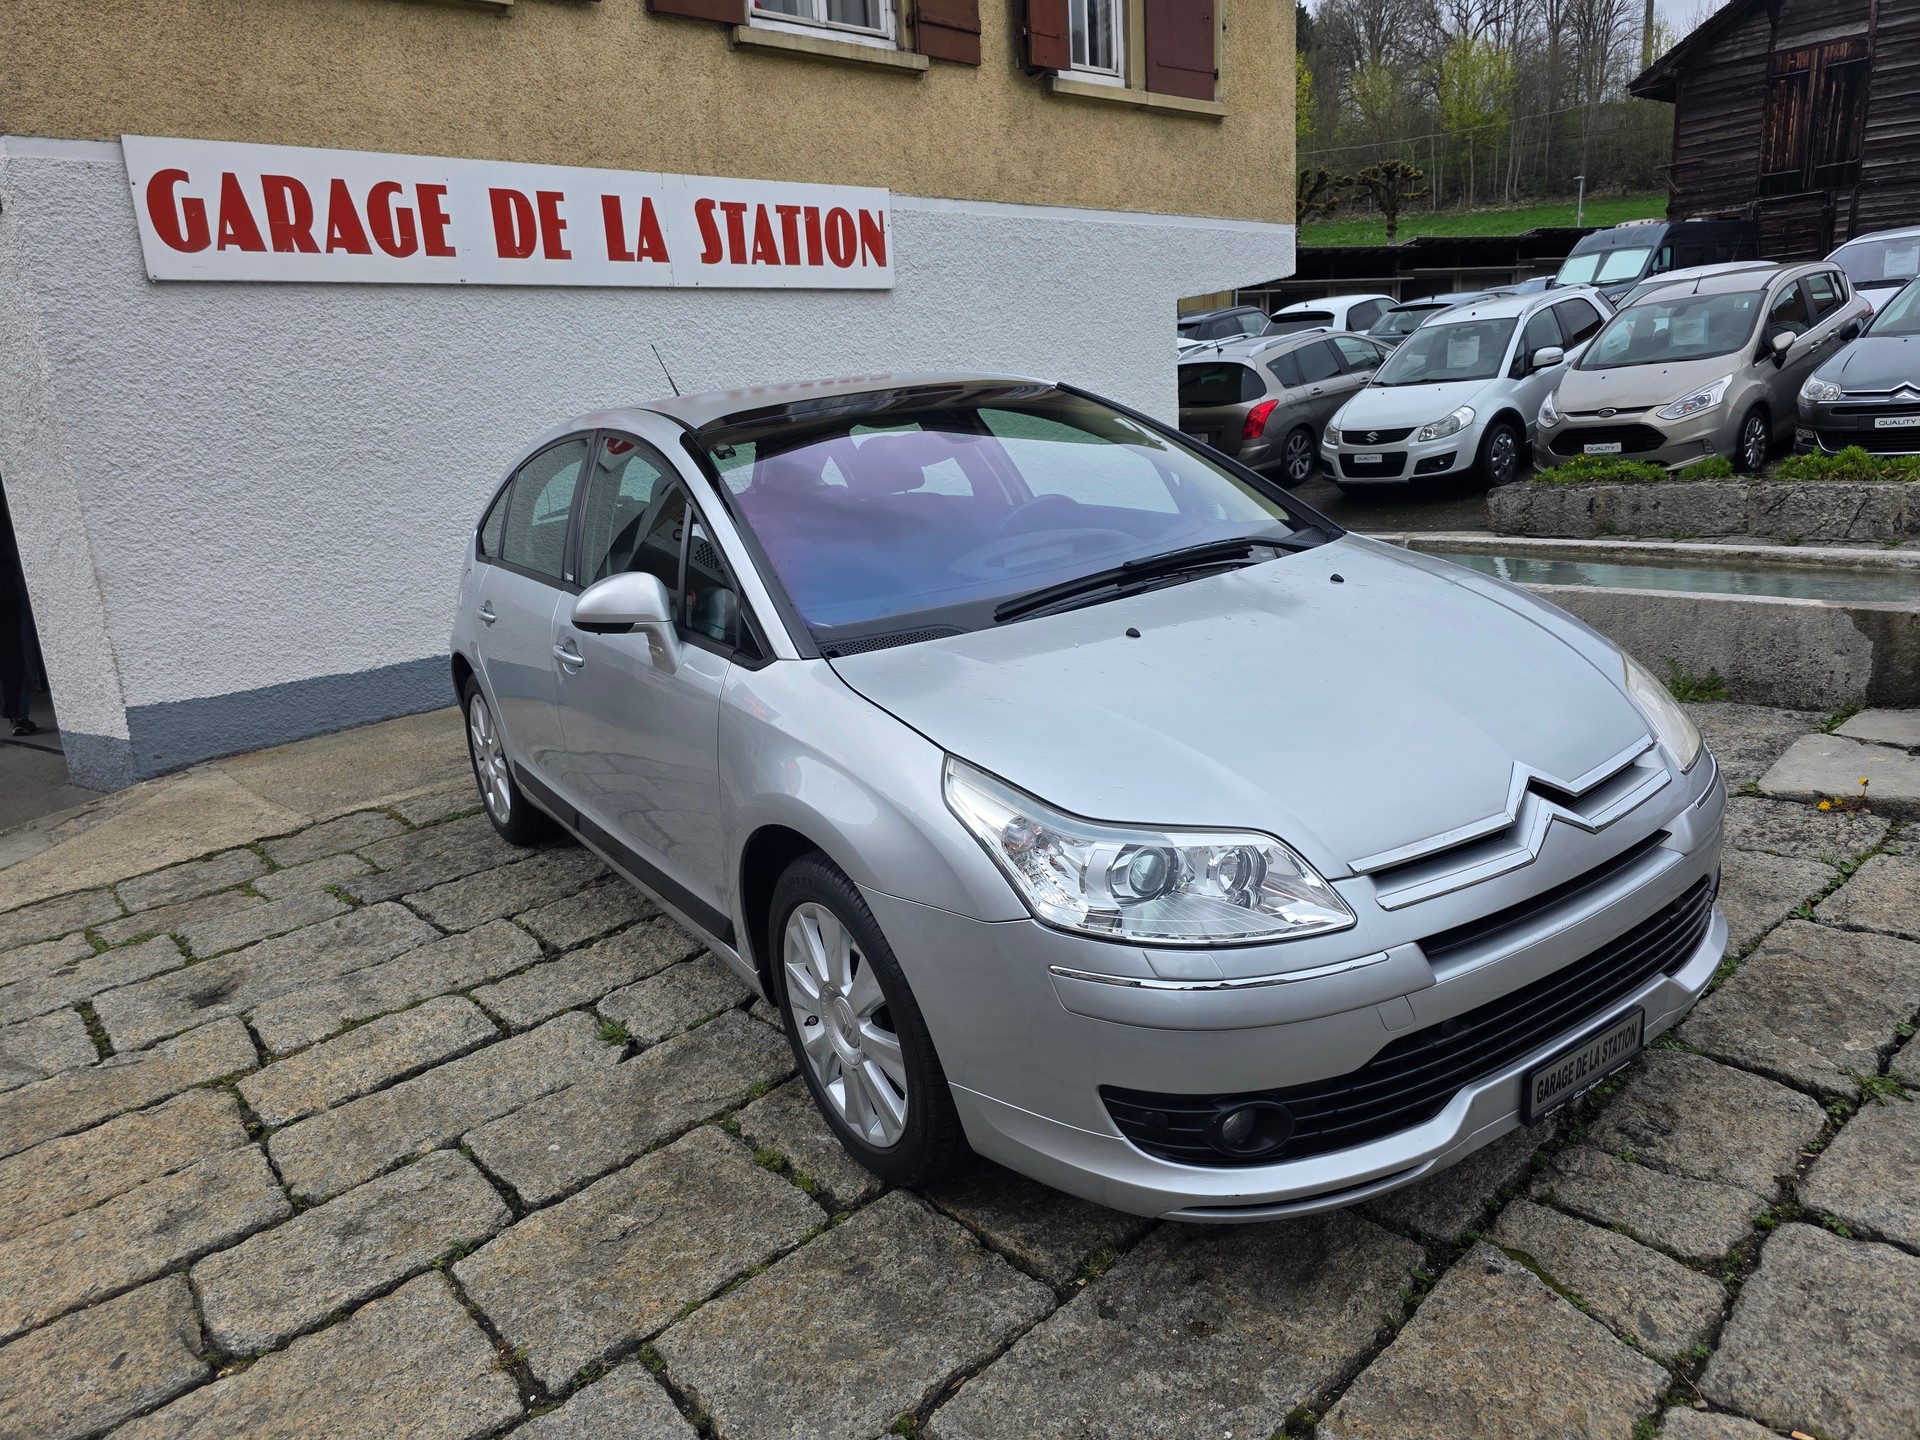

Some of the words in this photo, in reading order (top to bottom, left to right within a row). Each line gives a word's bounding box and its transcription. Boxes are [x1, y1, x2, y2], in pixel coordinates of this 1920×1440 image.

[146, 168, 456, 257] GARAGE
[489, 187, 572, 260] DE
[601, 194, 670, 262] LA
[694, 197, 887, 267] STATION
[1537, 1061, 1574, 1104] GARAGE
[1576, 1053, 1588, 1081] DE
[1589, 1045, 1600, 1072] LA
[1602, 1022, 1637, 1063] STATION
